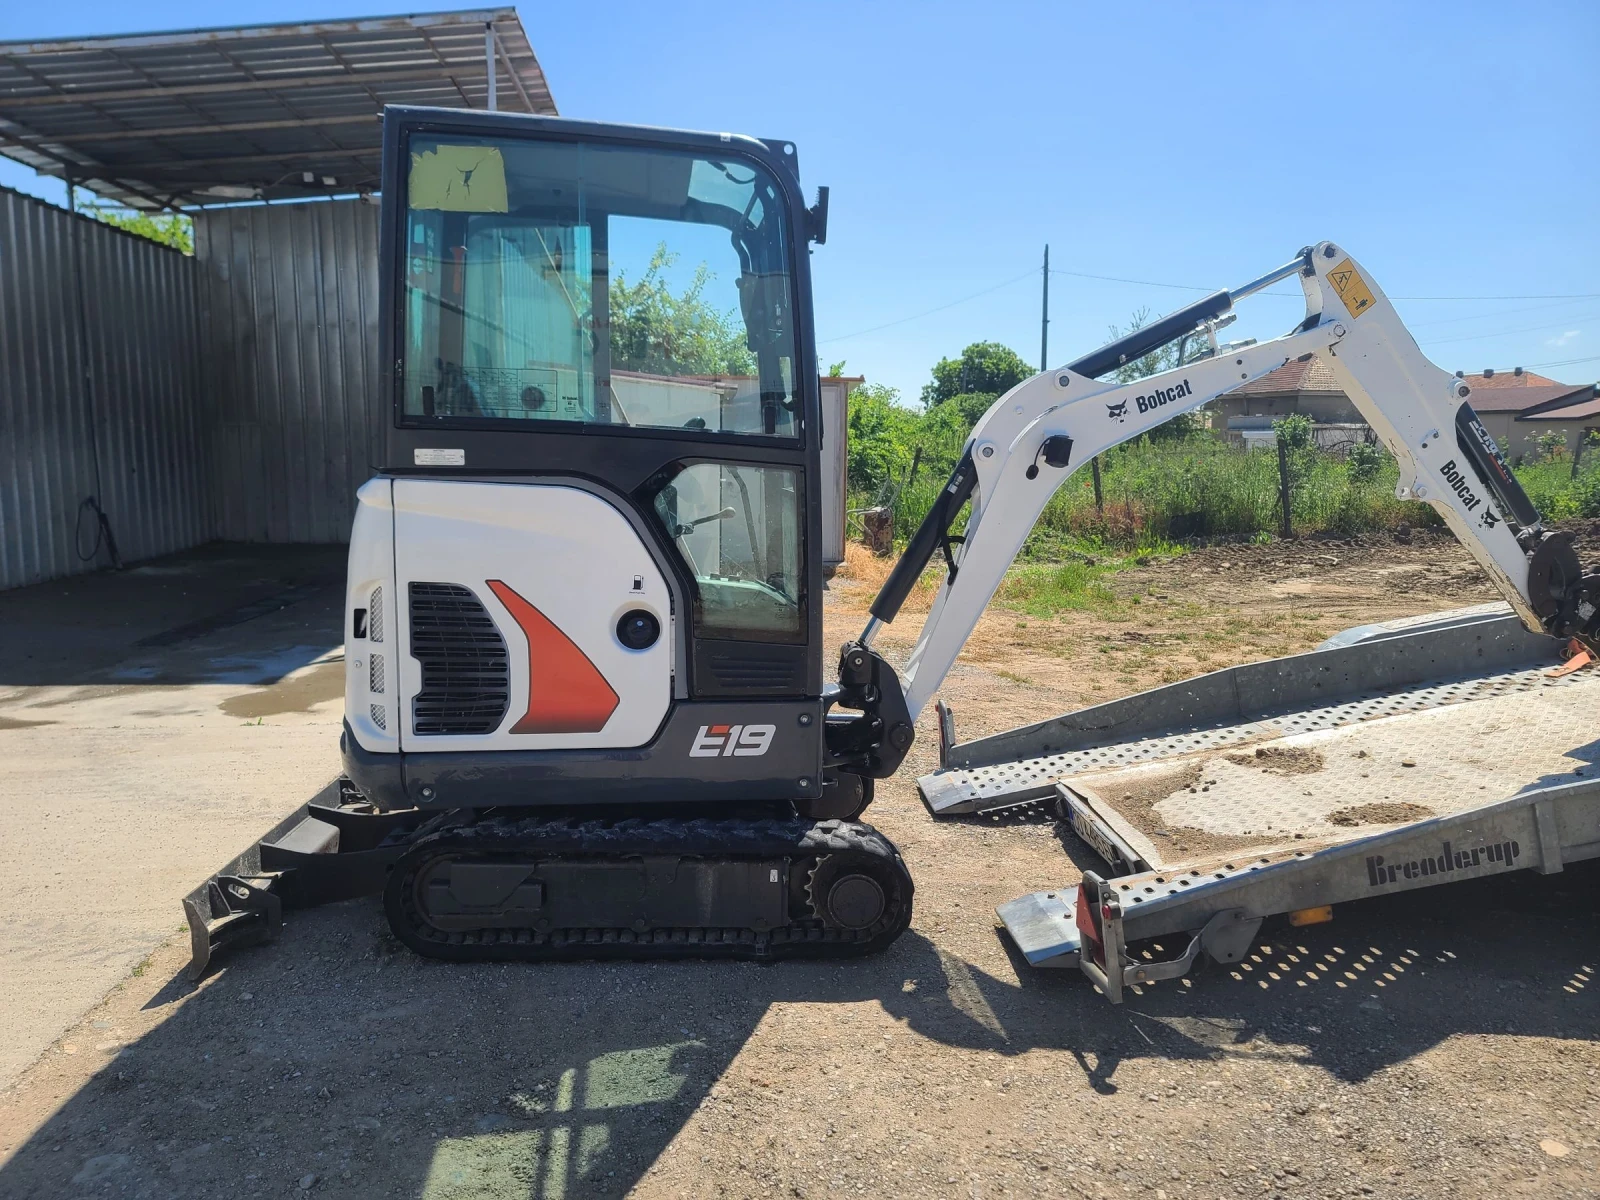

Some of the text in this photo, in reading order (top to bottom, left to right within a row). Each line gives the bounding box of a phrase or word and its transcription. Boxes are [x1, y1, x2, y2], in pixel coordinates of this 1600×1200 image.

[1135, 379, 1193, 414] Bobcat
[1439, 459, 1482, 512] Bobcat
[689, 724, 777, 758] E19
[1366, 840, 1520, 887] Brenderup
